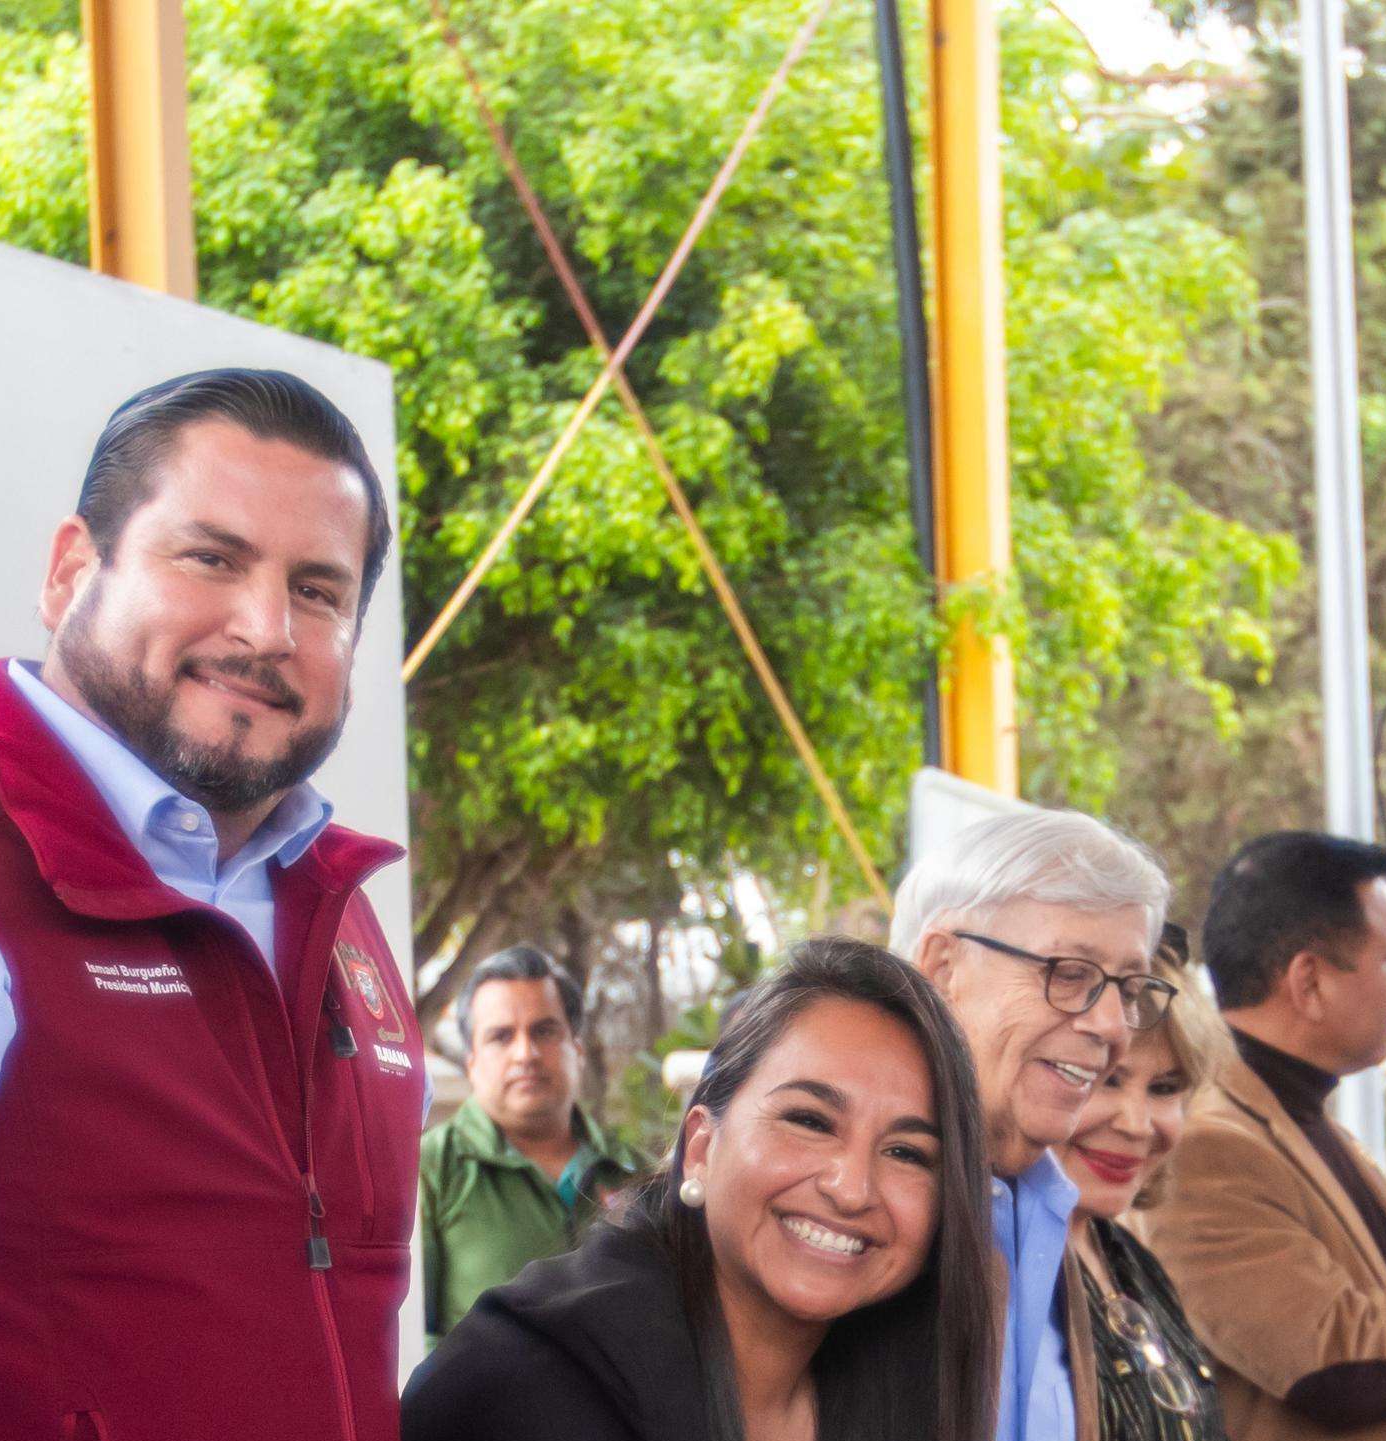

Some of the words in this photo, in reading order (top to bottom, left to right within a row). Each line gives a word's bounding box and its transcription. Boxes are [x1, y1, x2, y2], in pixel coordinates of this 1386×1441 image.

[85, 962, 119, 975] Ismael
[119, 964, 177, 980] Burgueño
[95, 977, 148, 994] Presidente
[149, 980, 192, 996] Munic
